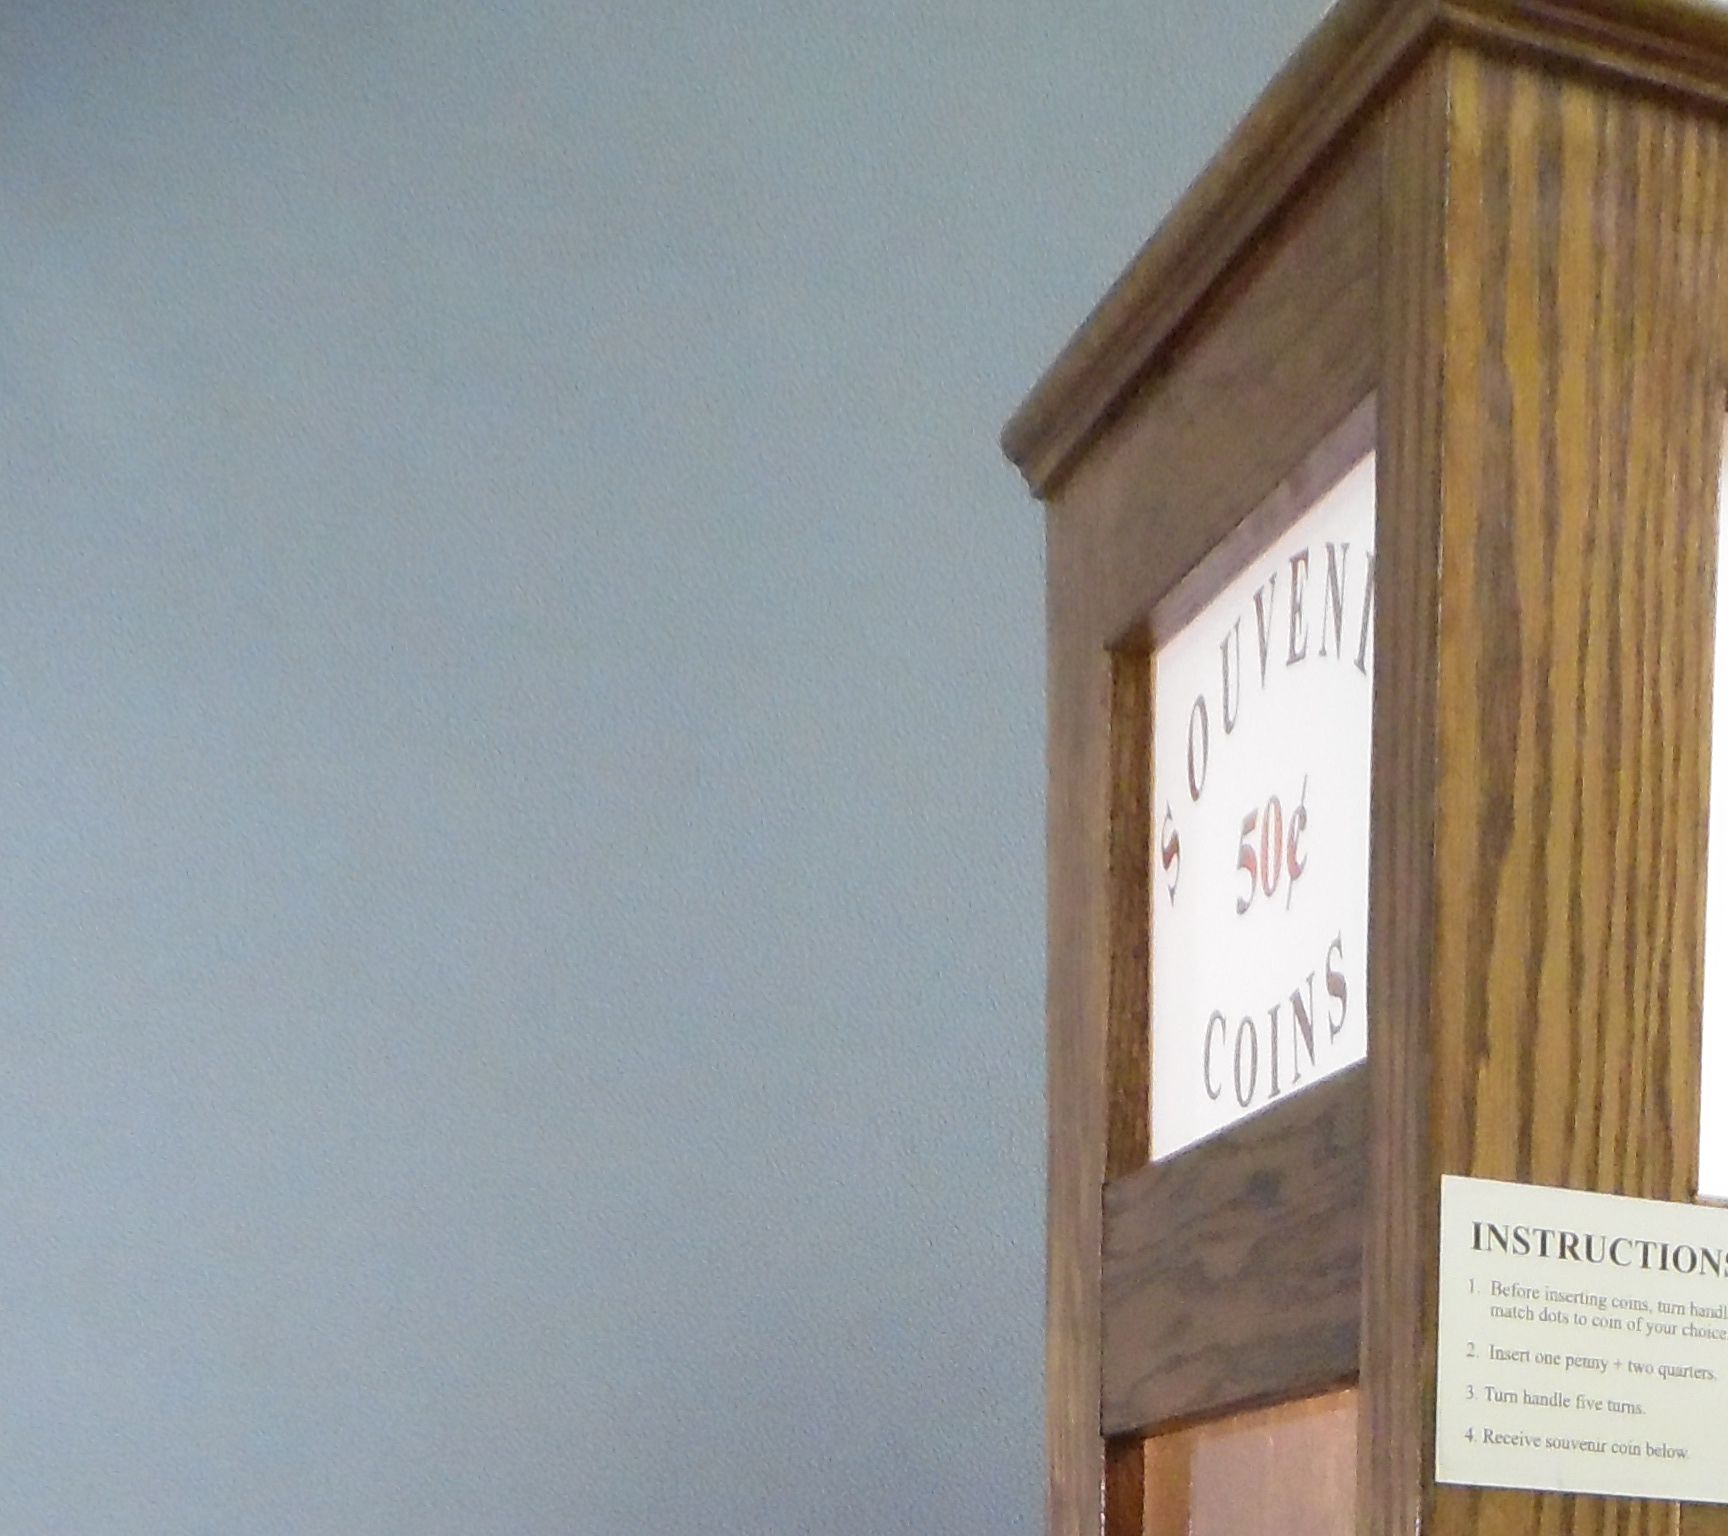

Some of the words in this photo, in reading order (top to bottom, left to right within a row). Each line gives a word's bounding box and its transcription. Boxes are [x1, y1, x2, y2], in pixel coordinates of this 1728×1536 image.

[1236, 773, 1309, 915] 50¢
[1203, 931, 1347, 1108] COINS
[1468, 1279, 1480, 1294] 1.
[1491, 1280, 1540, 1300] Before
[1544, 1286, 1606, 1311] inserting
[1612, 1297, 1652, 1316] coins,
[1658, 1300, 1685, 1317] turn
[1491, 1305, 1534, 1322] match
[1539, 1308, 1568, 1324] dots
[1574, 1313, 1587, 1326] to
[1592, 1314, 1621, 1329] coin
[1626, 1316, 1642, 1332] of
[1646, 1321, 1677, 1337] your
[1467, 1342, 1479, 1359] 2.
[1489, 1345, 1530, 1363] Insert
[1535, 1352, 1560, 1365] one
[1565, 1355, 1608, 1373] penny
[1628, 1360, 1652, 1374] two
[1659, 1364, 1717, 1381] quarters.
[1465, 1385, 1478, 1400] 3.
[1485, 1386, 1518, 1403] Turn
[1523, 1389, 1571, 1409] handle
[1576, 1393, 1602, 1411] five
[1607, 1398, 1646, 1415] turns.
[1464, 1427, 1478, 1442] 4.
[1483, 1429, 1541, 1448] Receive
[1545, 1436, 1606, 1452] souvenir
[1611, 1441, 1641, 1456] coin
